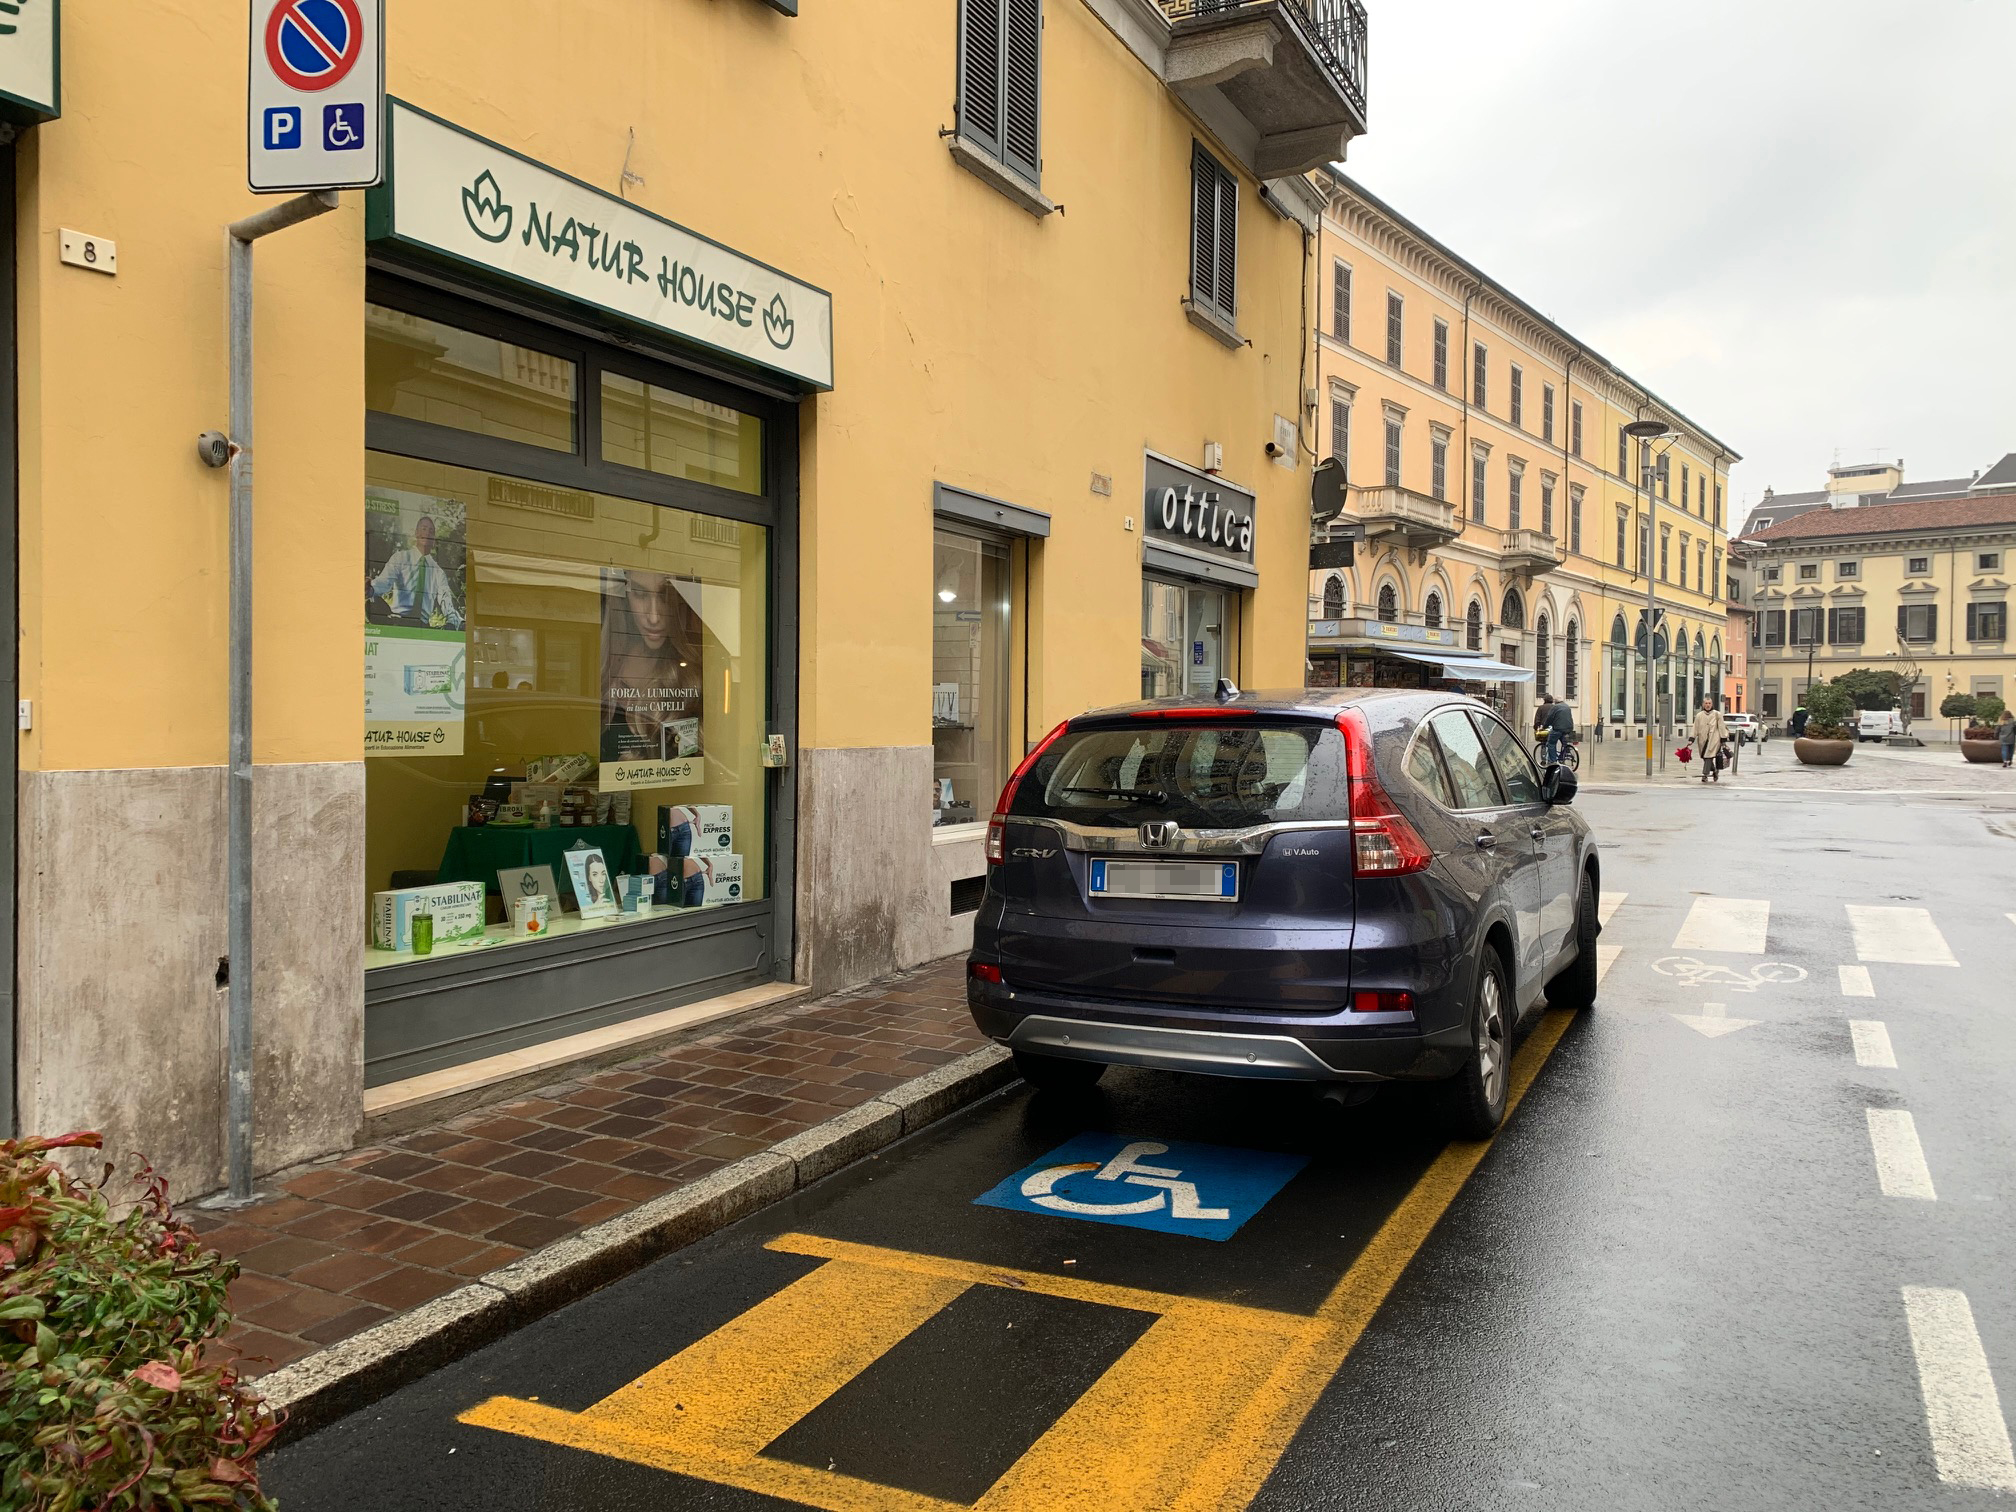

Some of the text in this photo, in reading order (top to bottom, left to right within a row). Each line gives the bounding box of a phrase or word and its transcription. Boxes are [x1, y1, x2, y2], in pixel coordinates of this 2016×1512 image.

[271, 112, 294, 144] P
[84, 241, 96, 263] 8
[522, 202, 757, 328] NATUR HOUSE
[371, 500, 397, 514] STRESS
[1162, 483, 1253, 552] ottica
[611, 688, 640, 698] FORZA
[647, 685, 699, 699] LUMINOSITÀ
[627, 701, 685, 712] ai tuoi CAPELLI
[396, 730, 431, 743] HOUSE
[627, 767, 681, 780] NATUR HOUSE
[703, 826, 731, 834] EXPRESS
[1294, 848, 1319, 857] V.Auto
[715, 875, 741, 884] EXPRESS
[431, 890, 482, 907] STABILINAT
